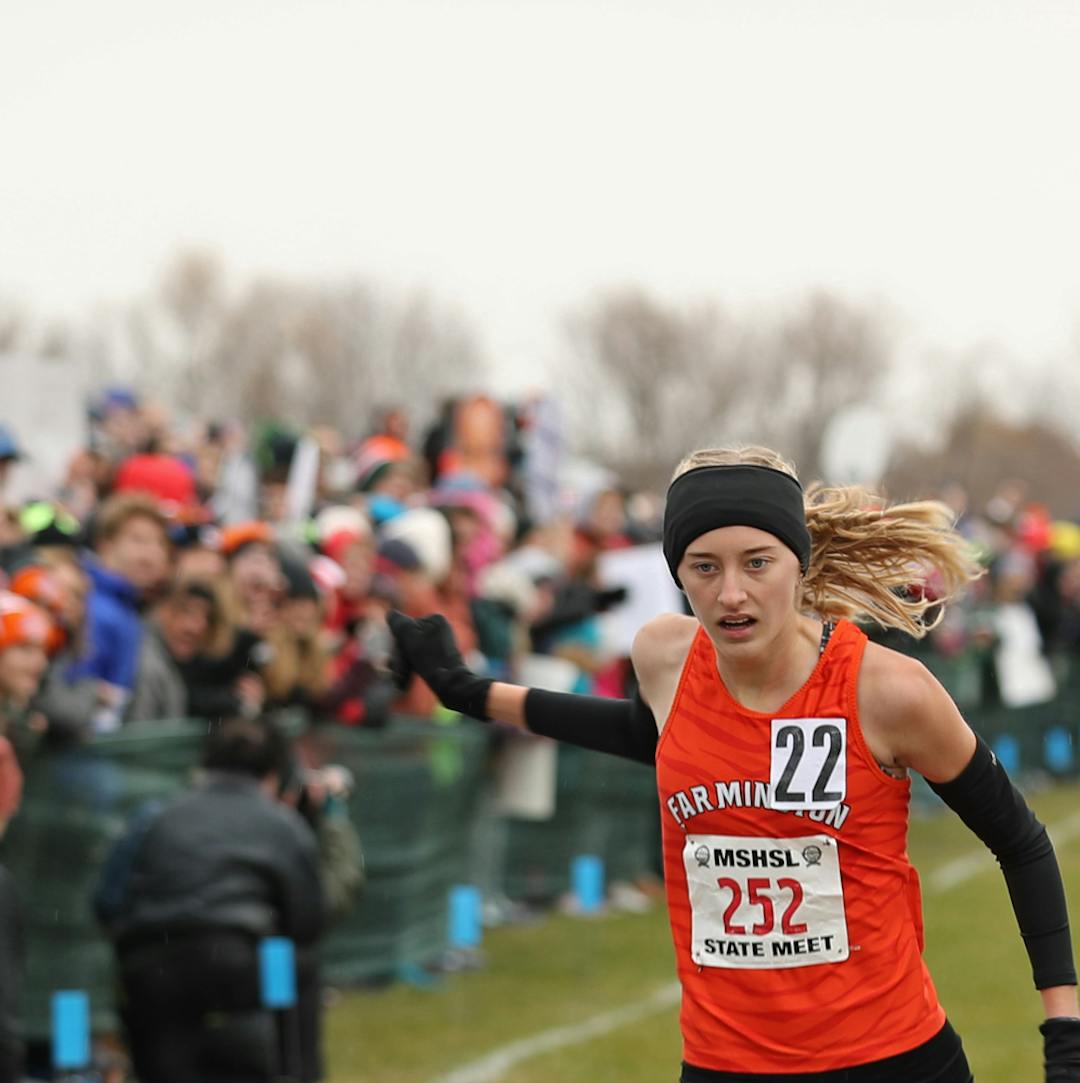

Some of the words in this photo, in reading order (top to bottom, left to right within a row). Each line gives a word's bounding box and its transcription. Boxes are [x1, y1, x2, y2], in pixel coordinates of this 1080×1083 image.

[775, 725, 843, 803] 22
[667, 781, 850, 830] FARMINN
[714, 848, 800, 868] MSHSL
[717, 877, 808, 936] 252
[704, 938, 765, 957] STATE
[772, 935, 834, 957] MEET
